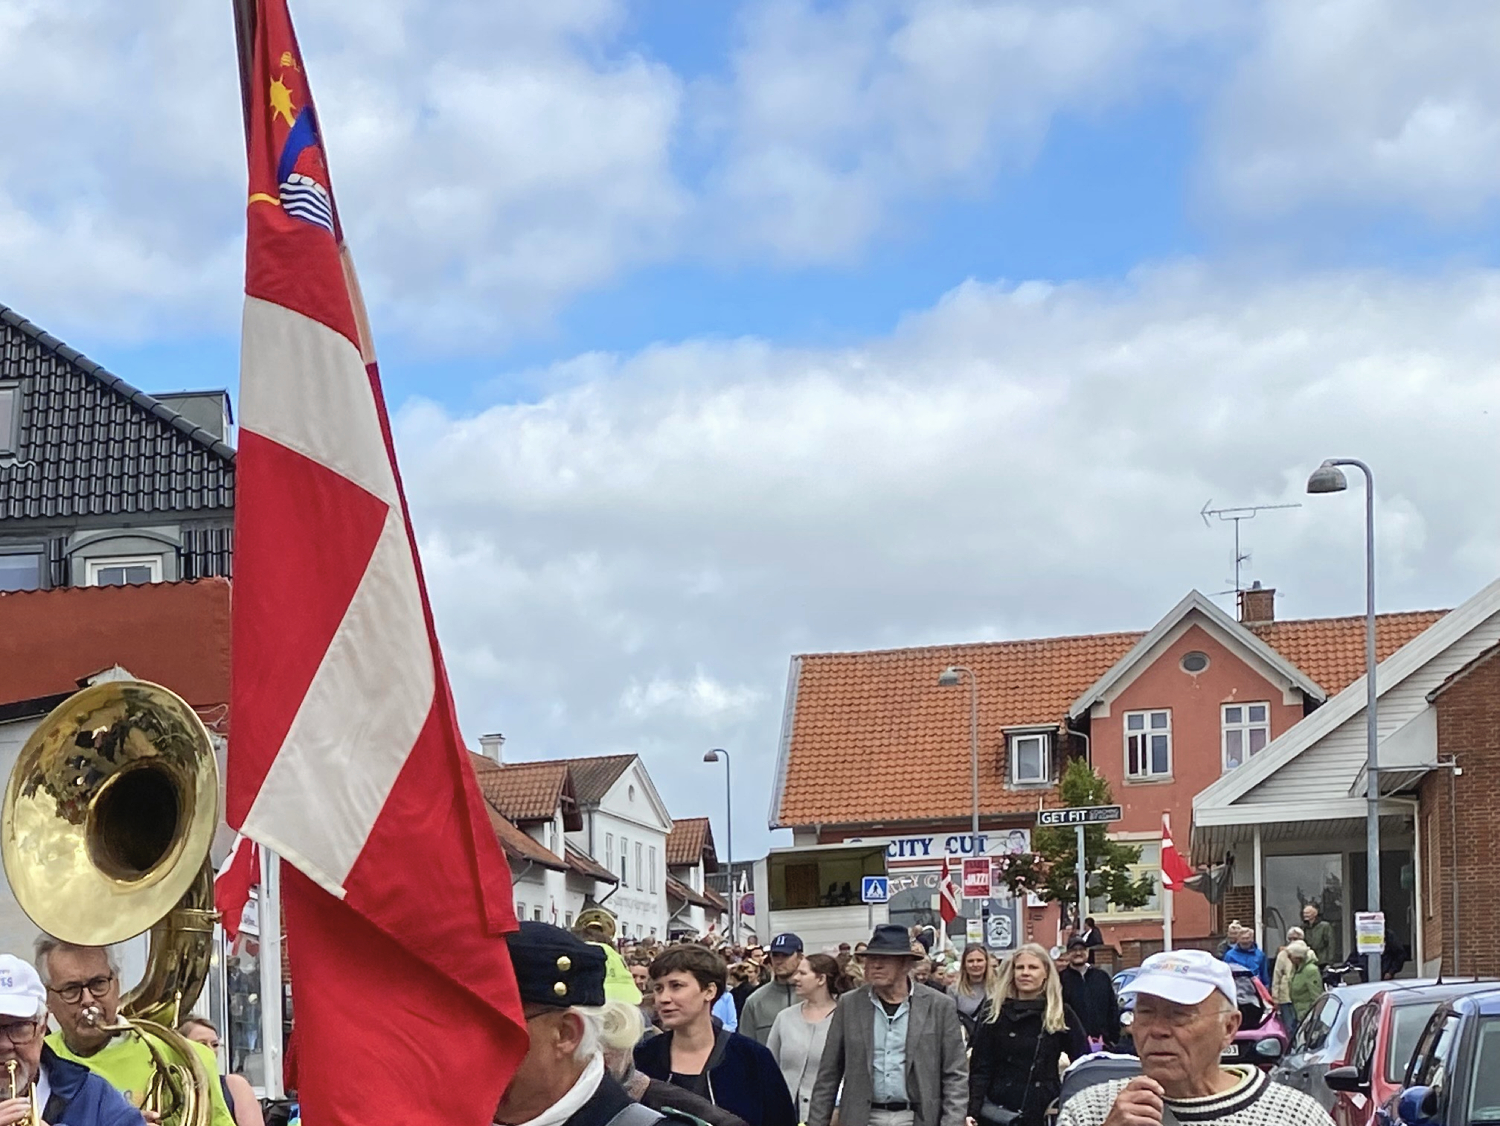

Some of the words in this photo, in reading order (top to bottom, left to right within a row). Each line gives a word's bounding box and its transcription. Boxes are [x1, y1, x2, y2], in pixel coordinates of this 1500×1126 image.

[1041, 812, 1066, 824] GET
[1068, 810, 1087, 822] FIT
[887, 837, 934, 858] CITY
[945, 834, 989, 854] CUT
